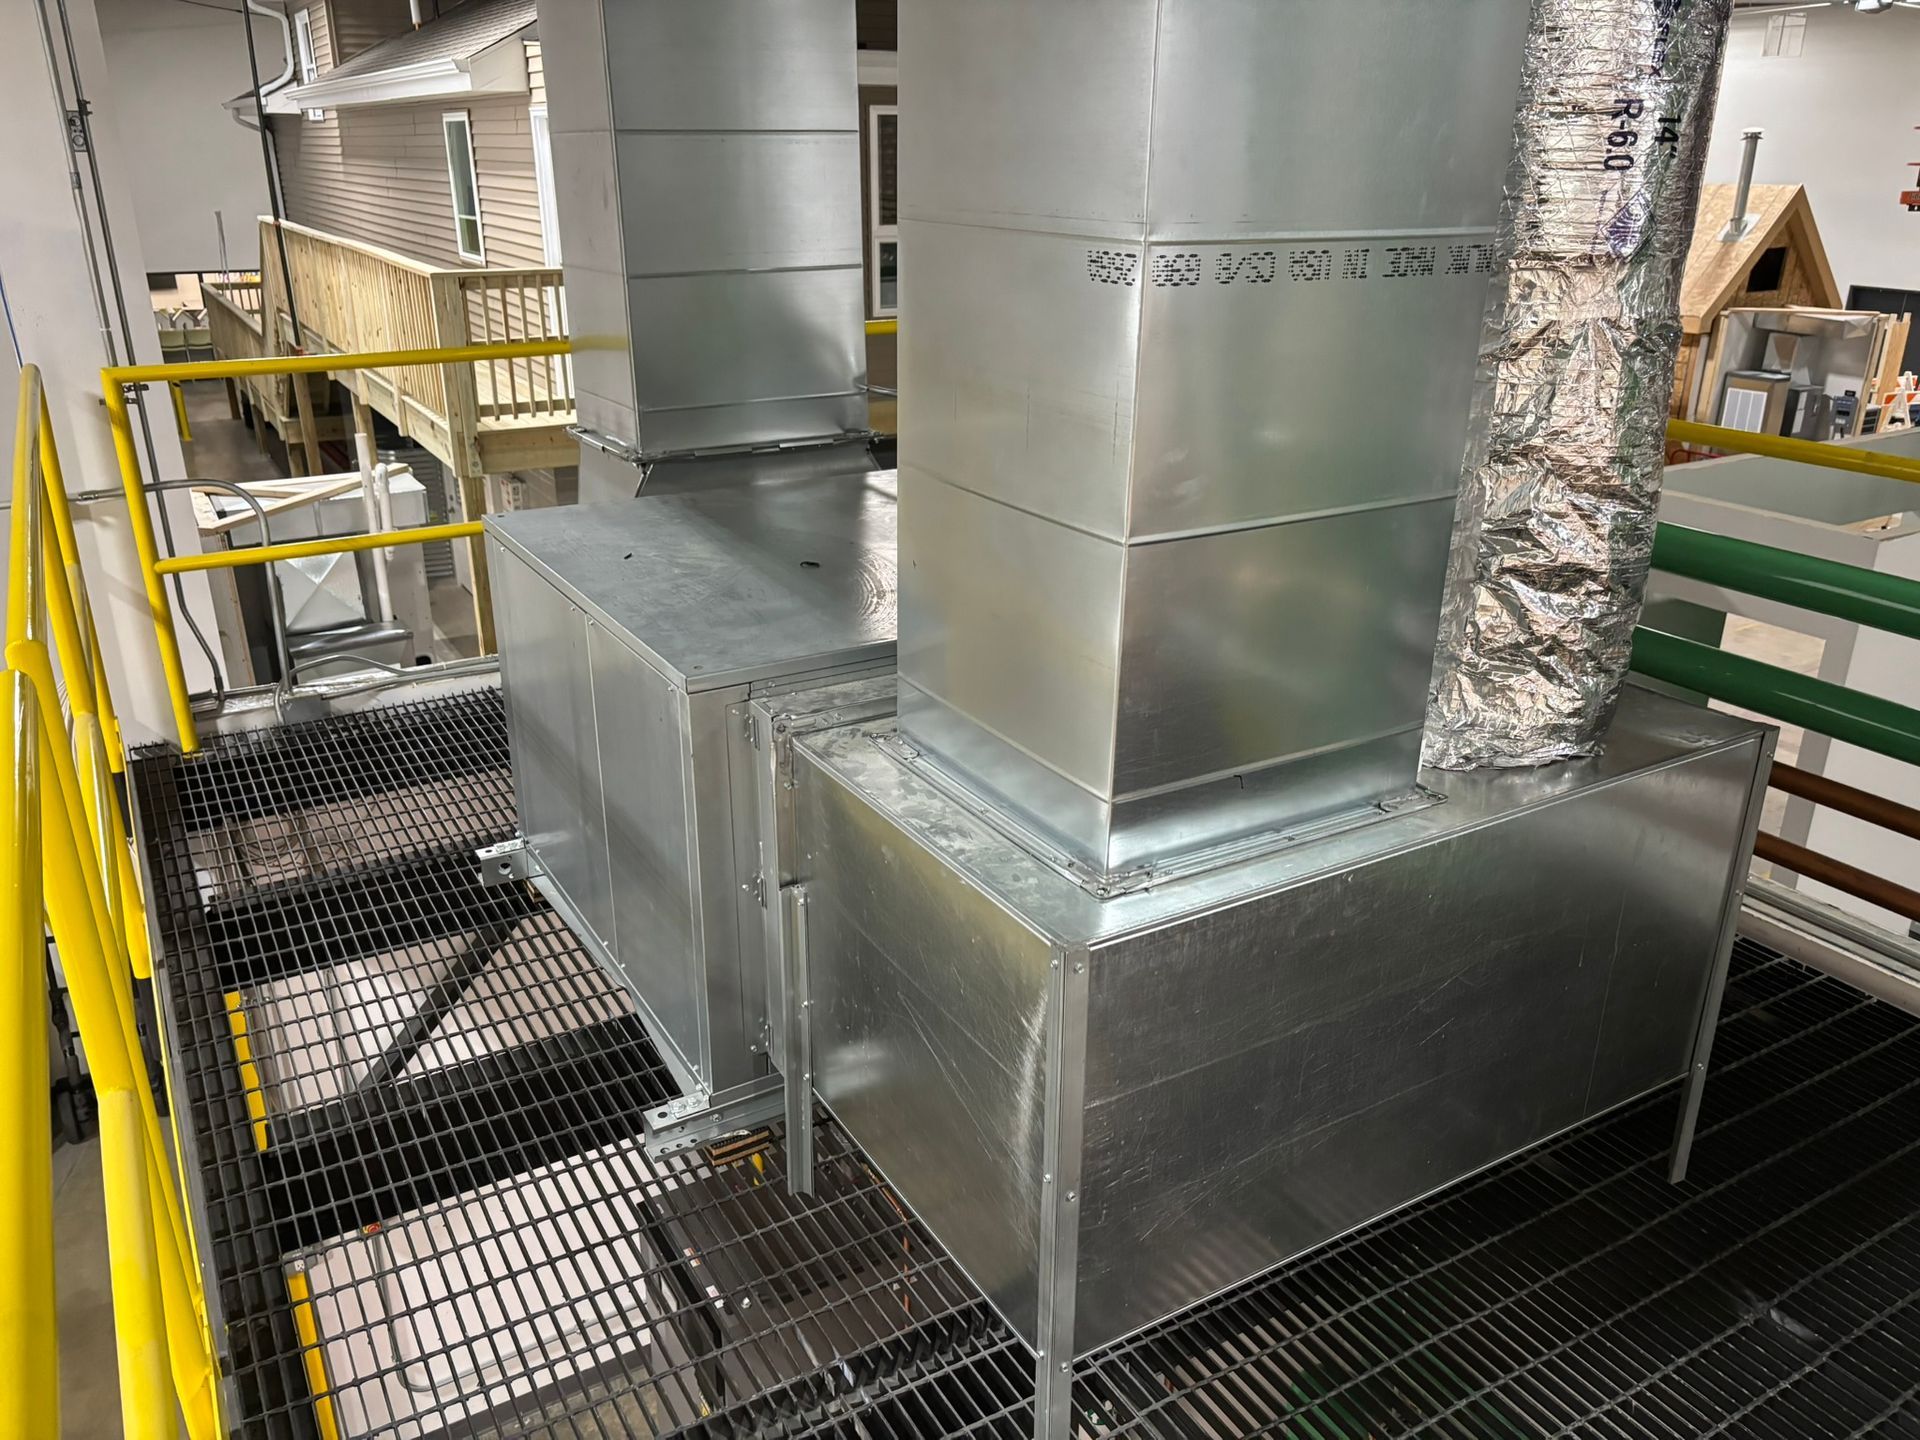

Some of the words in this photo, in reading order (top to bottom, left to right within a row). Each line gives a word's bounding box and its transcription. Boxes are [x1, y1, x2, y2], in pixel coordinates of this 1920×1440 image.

[1603, 99, 1643, 171] R-6.0
[1287, 250, 1332, 281] USA
[1342, 248, 1370, 279] IN
[1382, 246, 1436, 277] MADE
